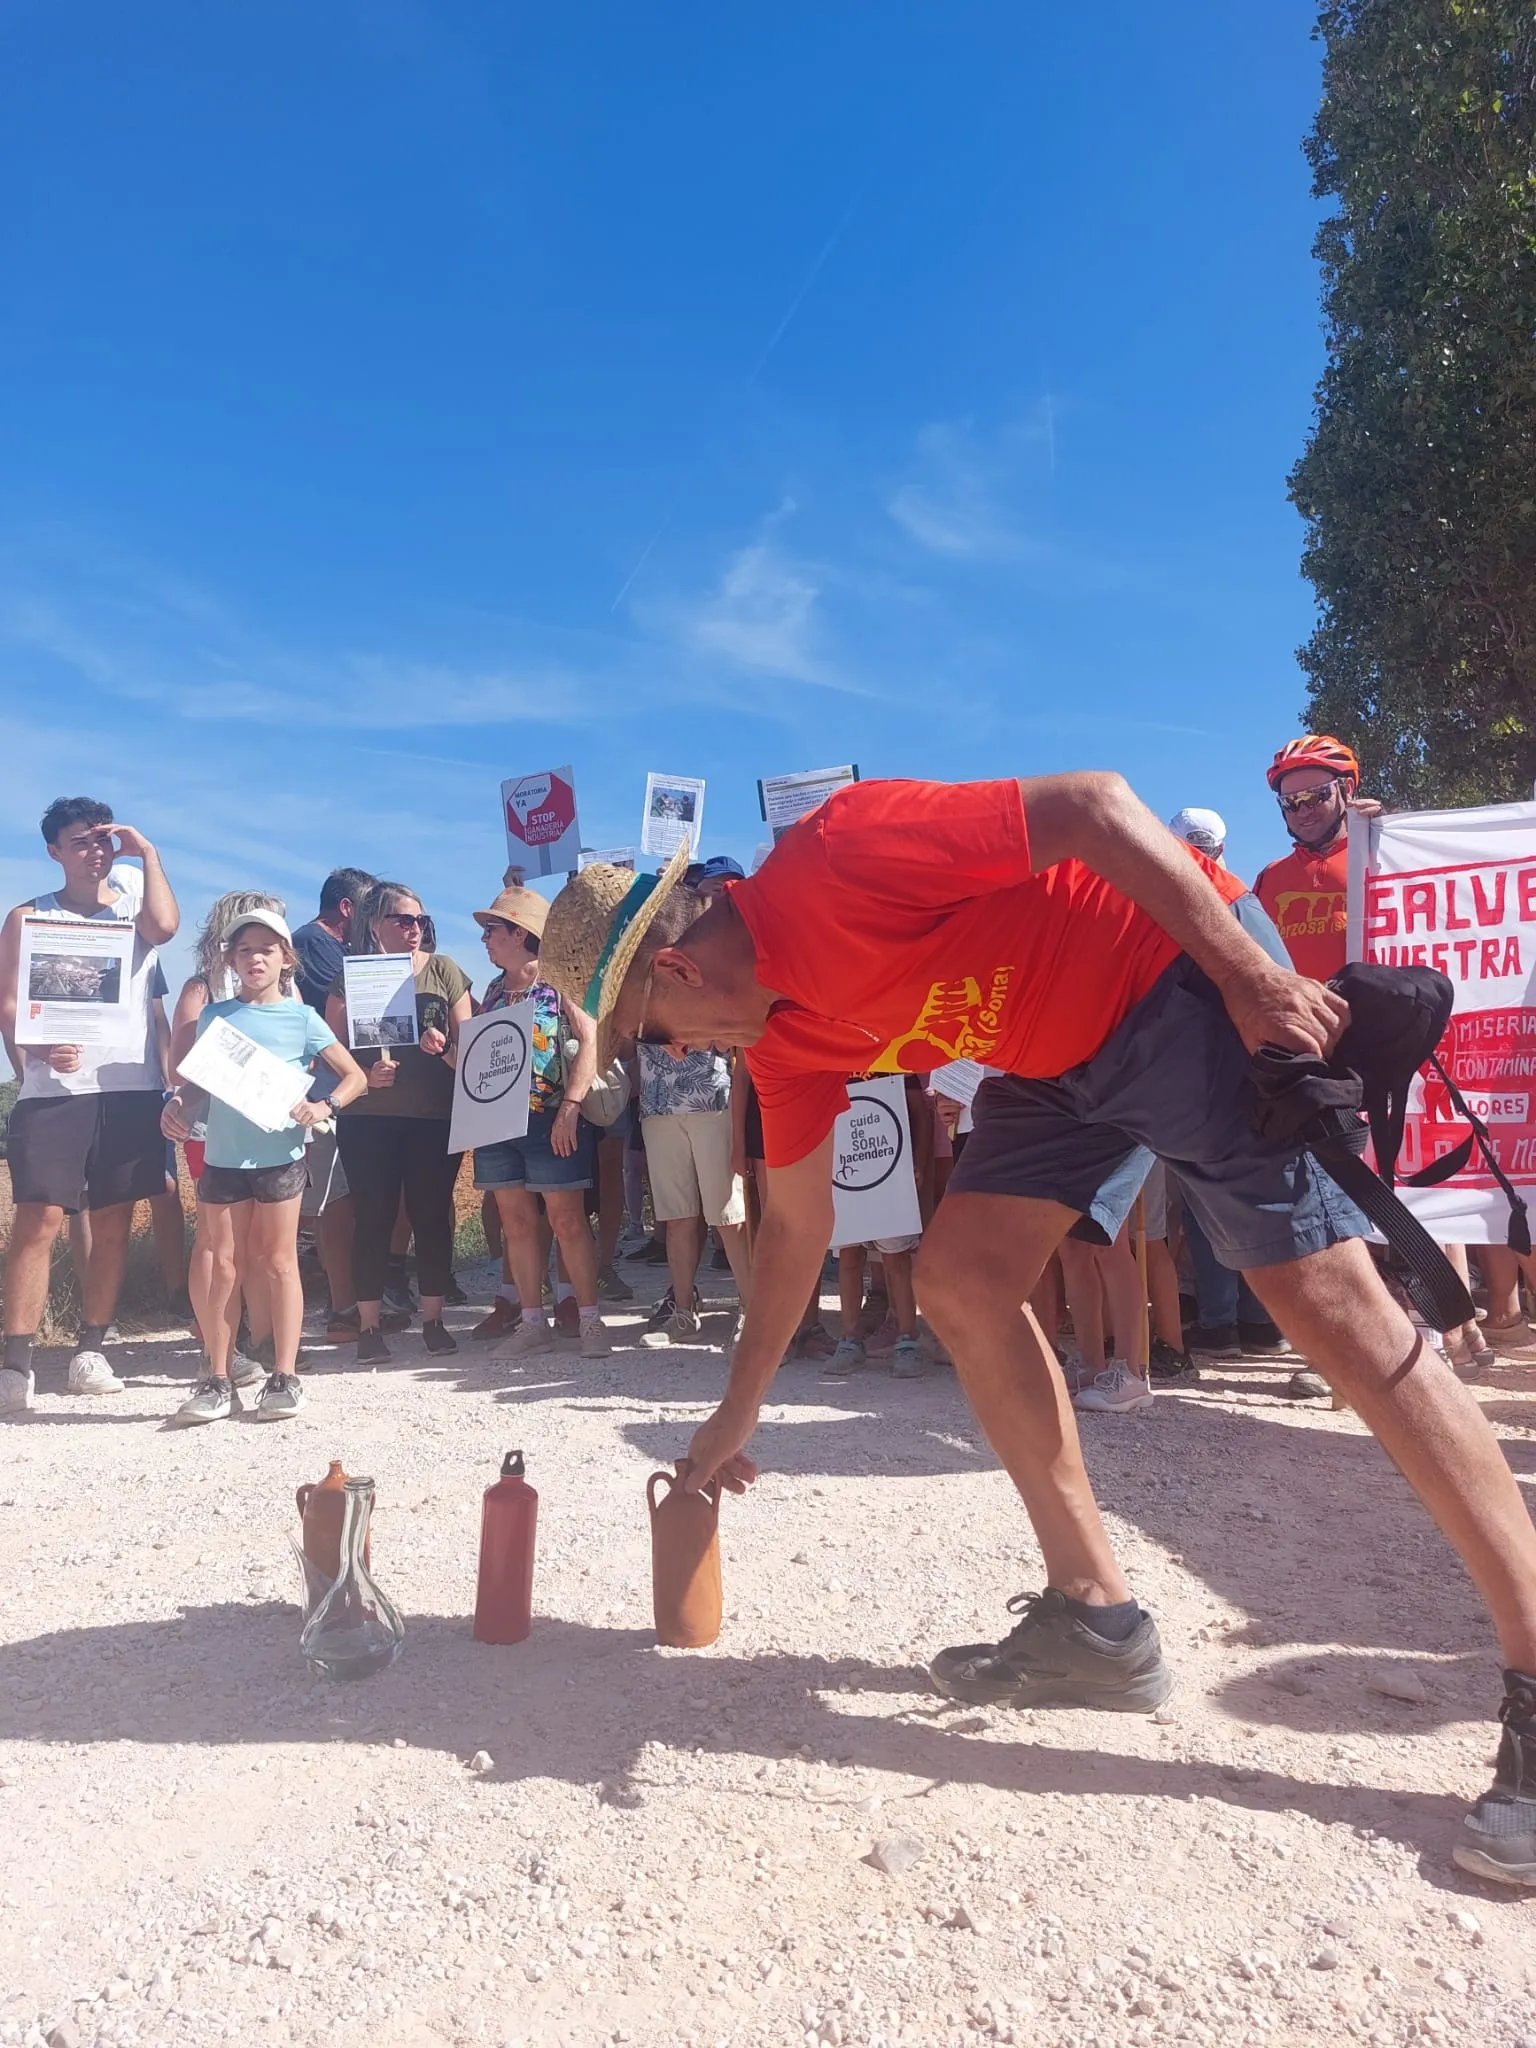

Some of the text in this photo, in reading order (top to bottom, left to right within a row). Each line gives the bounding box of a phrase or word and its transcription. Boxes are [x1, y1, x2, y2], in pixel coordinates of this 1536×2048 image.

[516, 799, 527, 809] YA
[531, 811, 556, 825] STOP
[1368, 868, 1536, 938] SALVE
[491, 1034, 513, 1049] cuida
[489, 1053, 516, 1069] SORIA
[490, 1048, 501, 1059] de
[479, 1063, 519, 1080] hacendera
[1456, 1098, 1525, 1116] LORES
[850, 1112, 880, 1128] cuida
[851, 1128, 865, 1140] de
[852, 1134, 888, 1151] SORIA
[839, 1145, 894, 1164] hacendera
